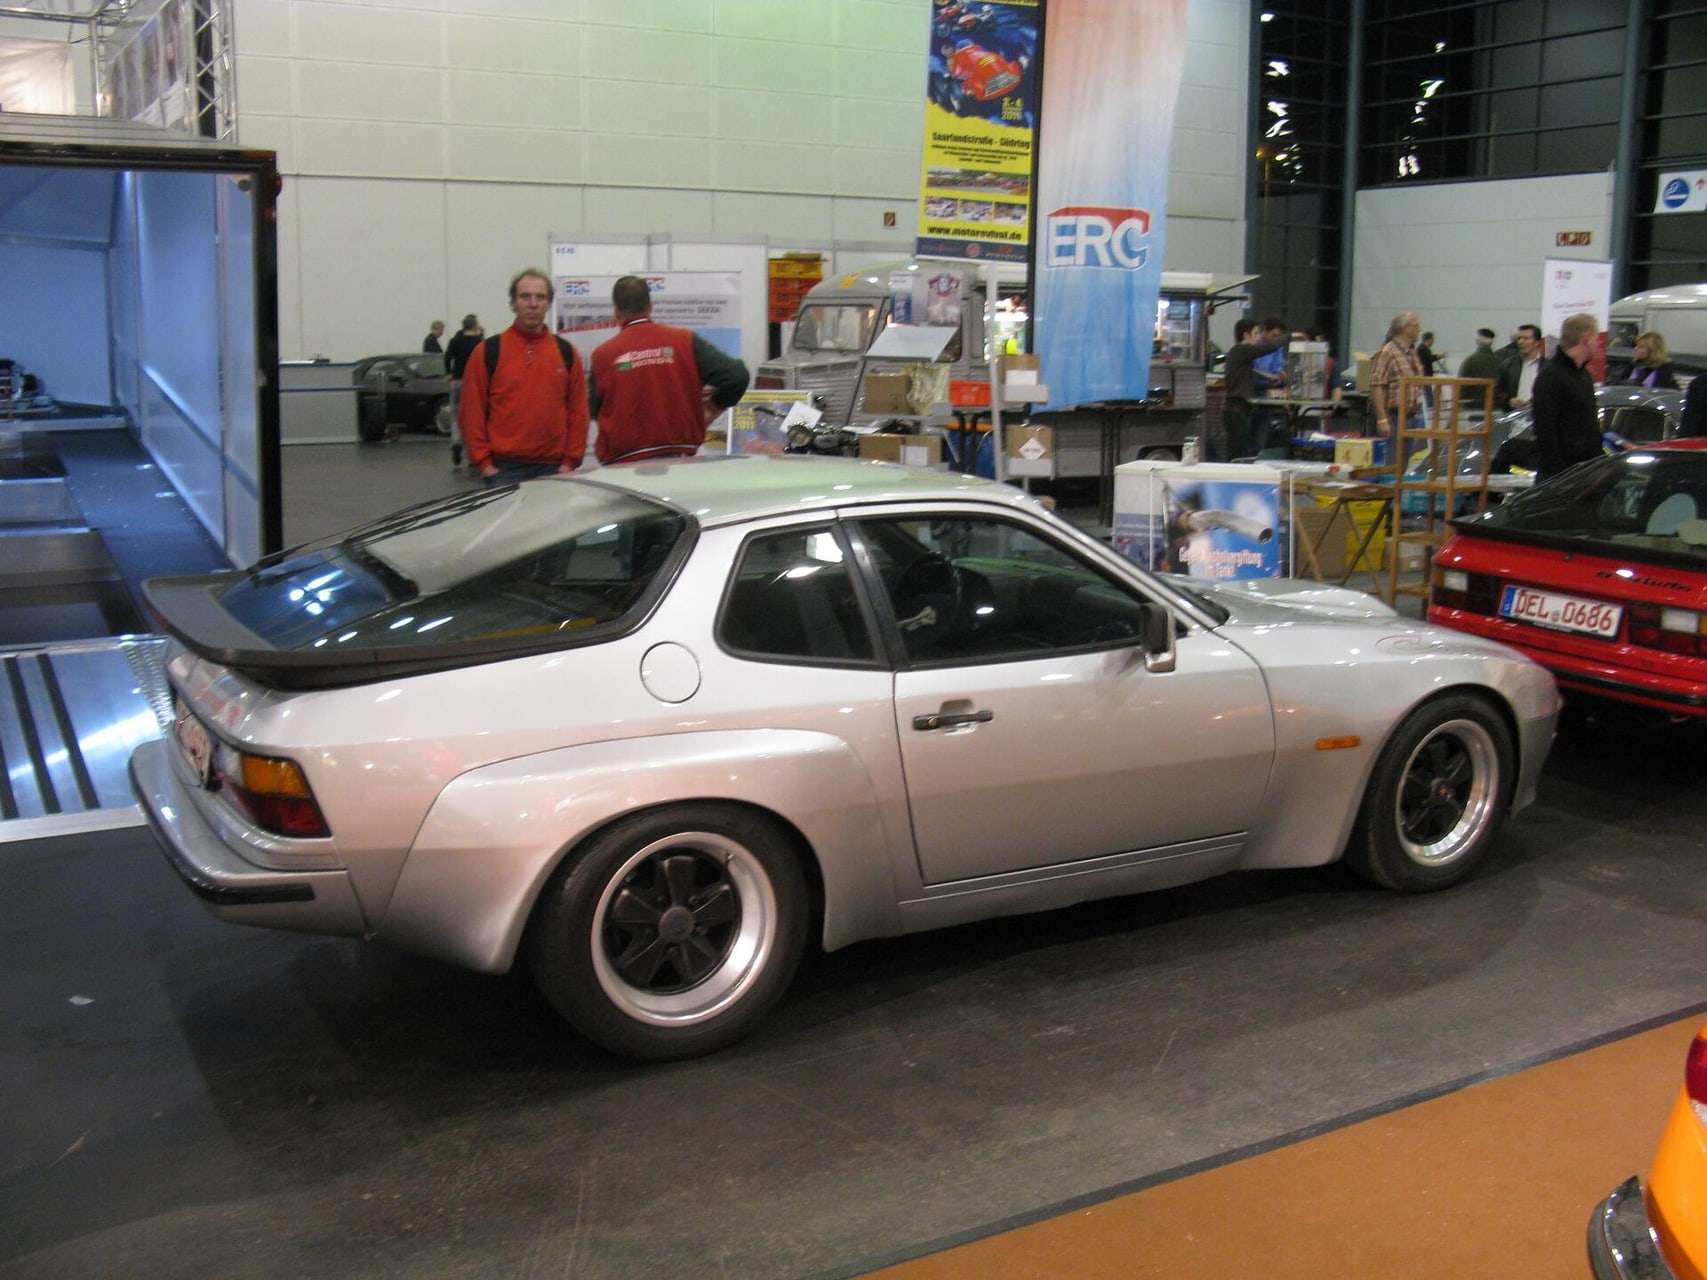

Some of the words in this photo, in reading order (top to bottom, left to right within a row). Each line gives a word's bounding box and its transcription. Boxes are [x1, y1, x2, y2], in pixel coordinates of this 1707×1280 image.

[1047, 207, 1150, 270] ERC
[1514, 589, 1550, 620] DEL
[1561, 601, 1613, 632] 0686
